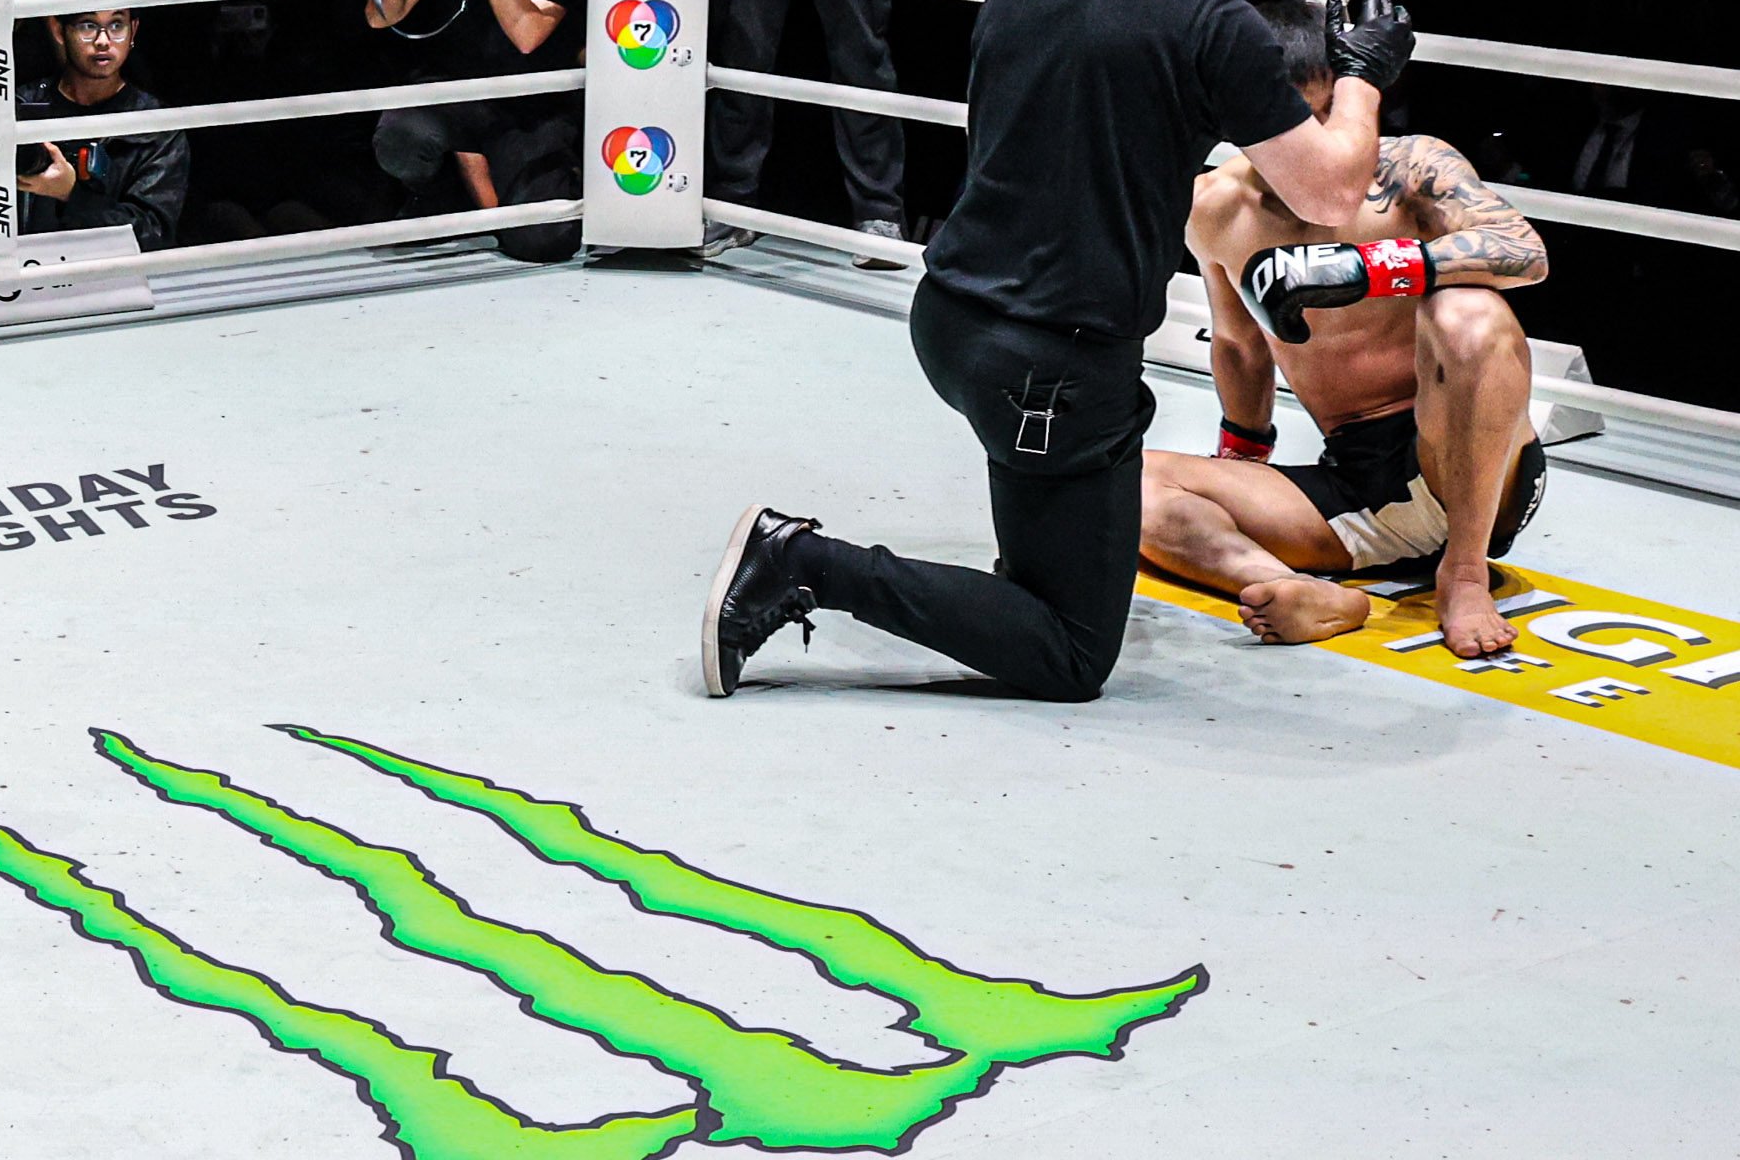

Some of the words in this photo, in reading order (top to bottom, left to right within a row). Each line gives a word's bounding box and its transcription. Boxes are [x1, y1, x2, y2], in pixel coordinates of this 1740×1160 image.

[633, 23, 652, 42] 7
[629, 150, 648, 168] 7
[1251, 242, 1342, 304] ONE
